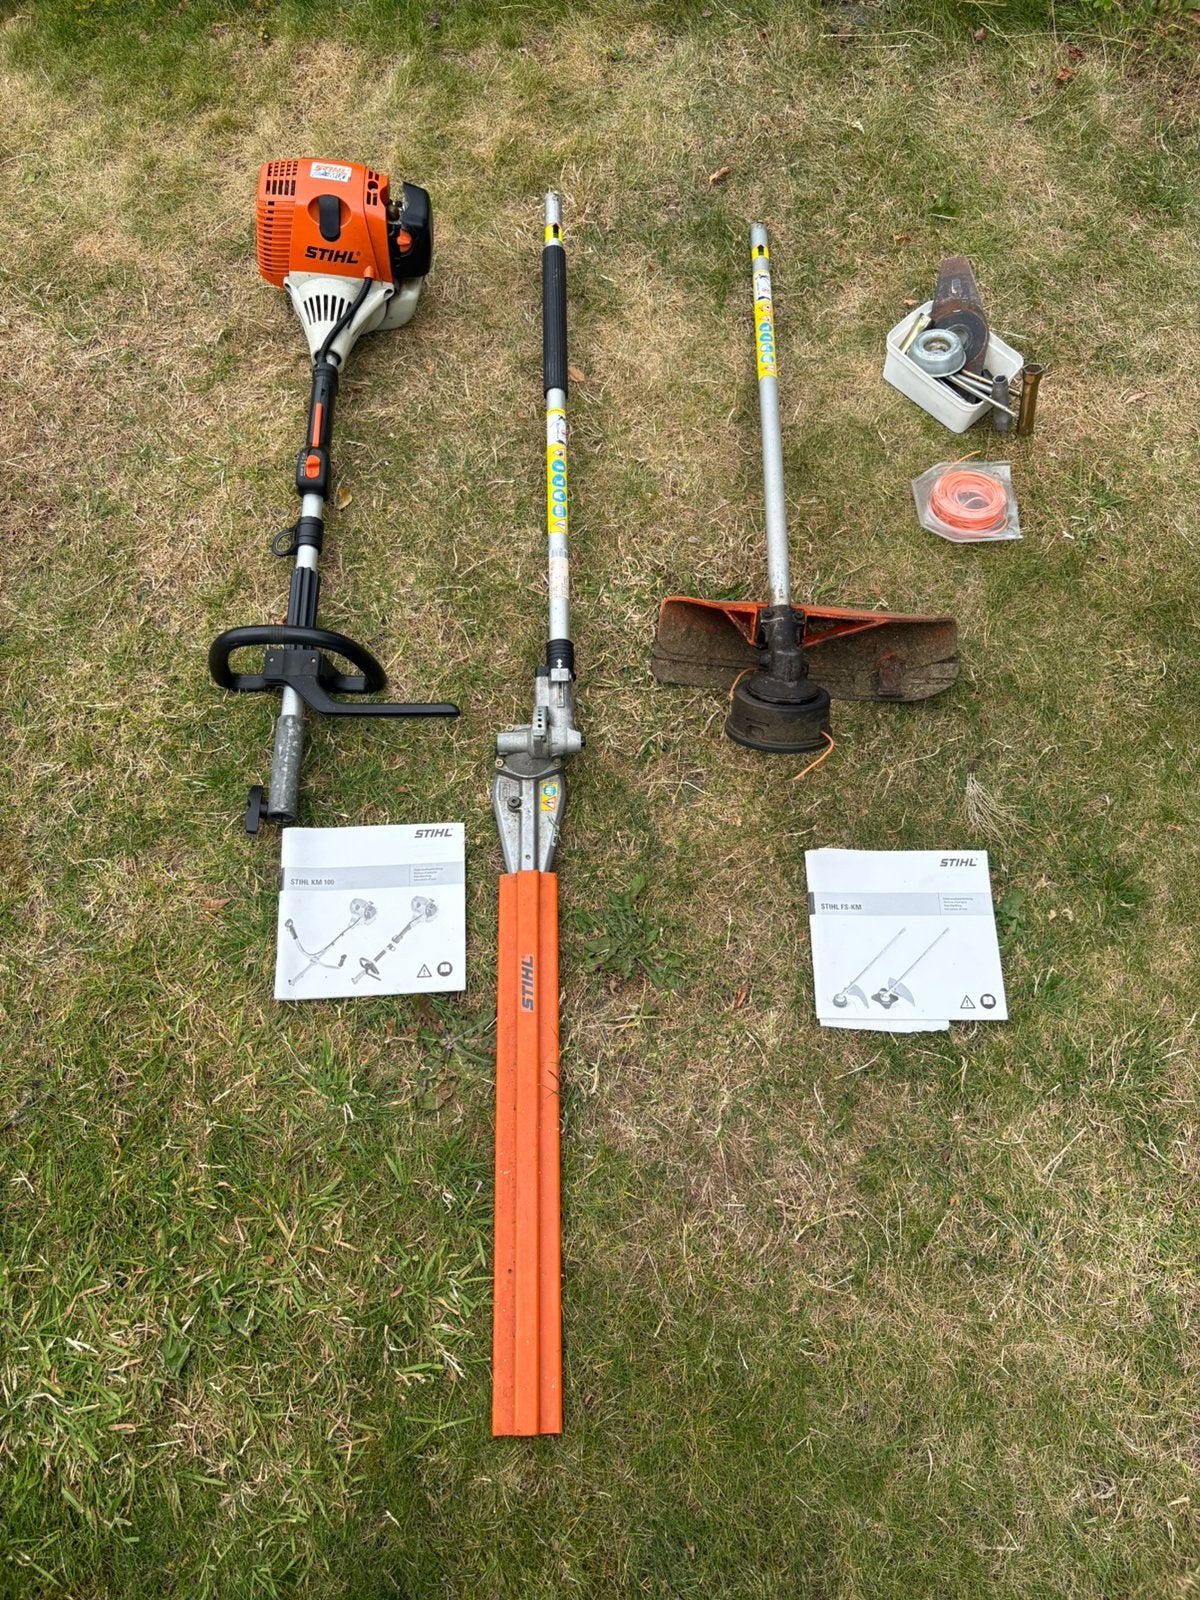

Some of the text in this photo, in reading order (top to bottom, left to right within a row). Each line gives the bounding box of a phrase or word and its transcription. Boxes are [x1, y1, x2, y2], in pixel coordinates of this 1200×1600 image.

[305, 245, 359, 264] STIHL
[414, 828, 453, 838] STIHL
[939, 858, 977, 867] STIHL
[290, 878, 309, 886] STIHL
[820, 903, 839, 911] STIHL
[521, 956, 534, 1011] STIHL
